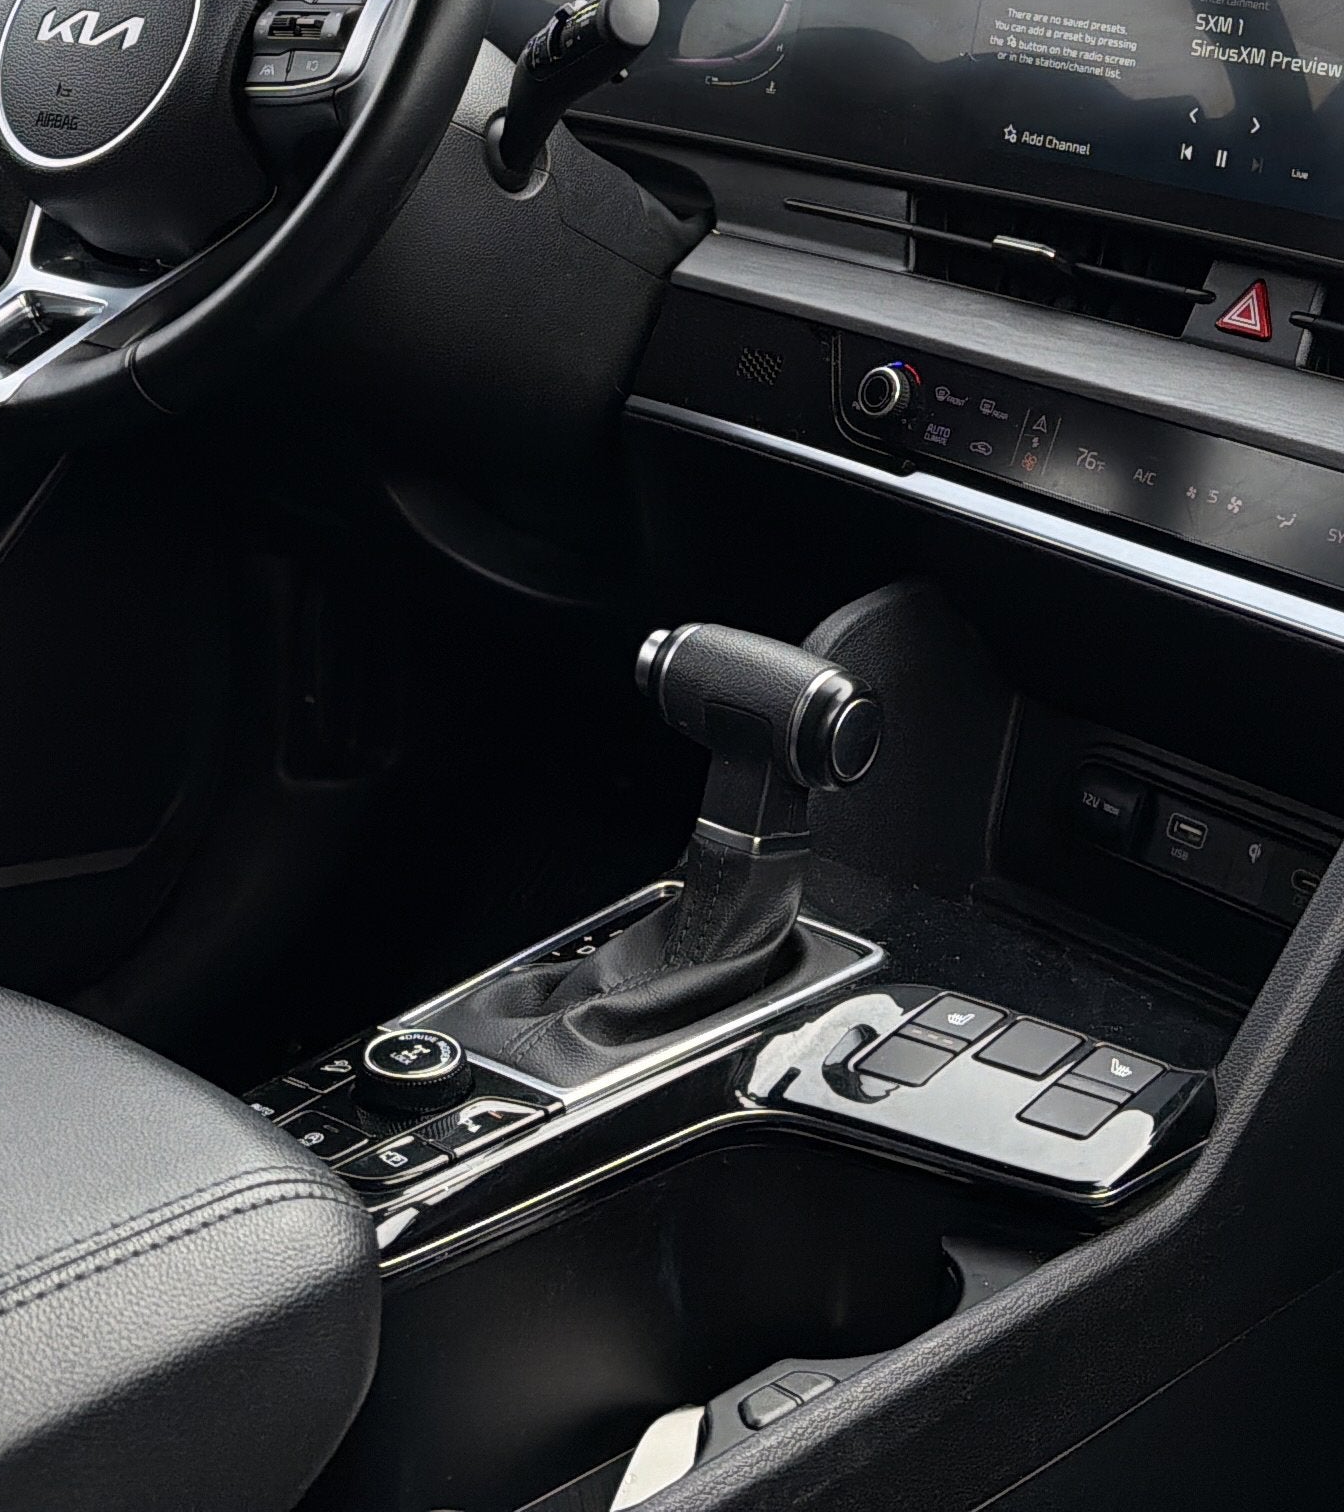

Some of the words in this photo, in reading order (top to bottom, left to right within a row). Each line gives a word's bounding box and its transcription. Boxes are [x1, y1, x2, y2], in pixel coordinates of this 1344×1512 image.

[36, 8, 146, 50] KIA
[1008, 7, 1032, 21] There
[1033, 13, 1048, 24] are
[1049, 15, 1062, 25] no
[1063, 16, 1090, 29] saved
[1194, 13, 1234, 35] SXM
[1238, 18, 1245, 37] 1
[994, 20, 1010, 32] You
[1010, 23, 1027, 34] can
[1027, 24, 1045, 36] add
[1045, 29, 1052, 37] a
[1053, 29, 1084, 43] preset
[1085, 34, 1097, 47] by
[1097, 38, 1138, 52] pressing
[989, 35, 1005, 47] the
[1018, 40, 1048, 53] button
[1048, 45, 1061, 56] on
[1062, 46, 1078, 58] the
[1078, 50, 1103, 63] radio
[1104, 54, 1137, 68] screen
[1190, 38, 1267, 67] SiriusXM
[1269, 49, 1344, 79] Preview
[997, 51, 1007, 60] or
[1008, 51, 1018, 62] in
[1018, 53, 1034, 65] the
[1034, 56, 1104, 77] station/channel
[36, 110, 79, 131] AIRBAG
[1020, 130, 1044, 147] Add
[1045, 135, 1092, 156] Channel
[1290, 168, 1310, 180] Live
[926, 422, 952, 439] AUTO
[1132, 468, 1158, 486] A/C
[1082, 791, 1102, 809] 12V
[1170, 846, 1190, 861] USB
[405, 1033, 438, 1043] DRIVE
